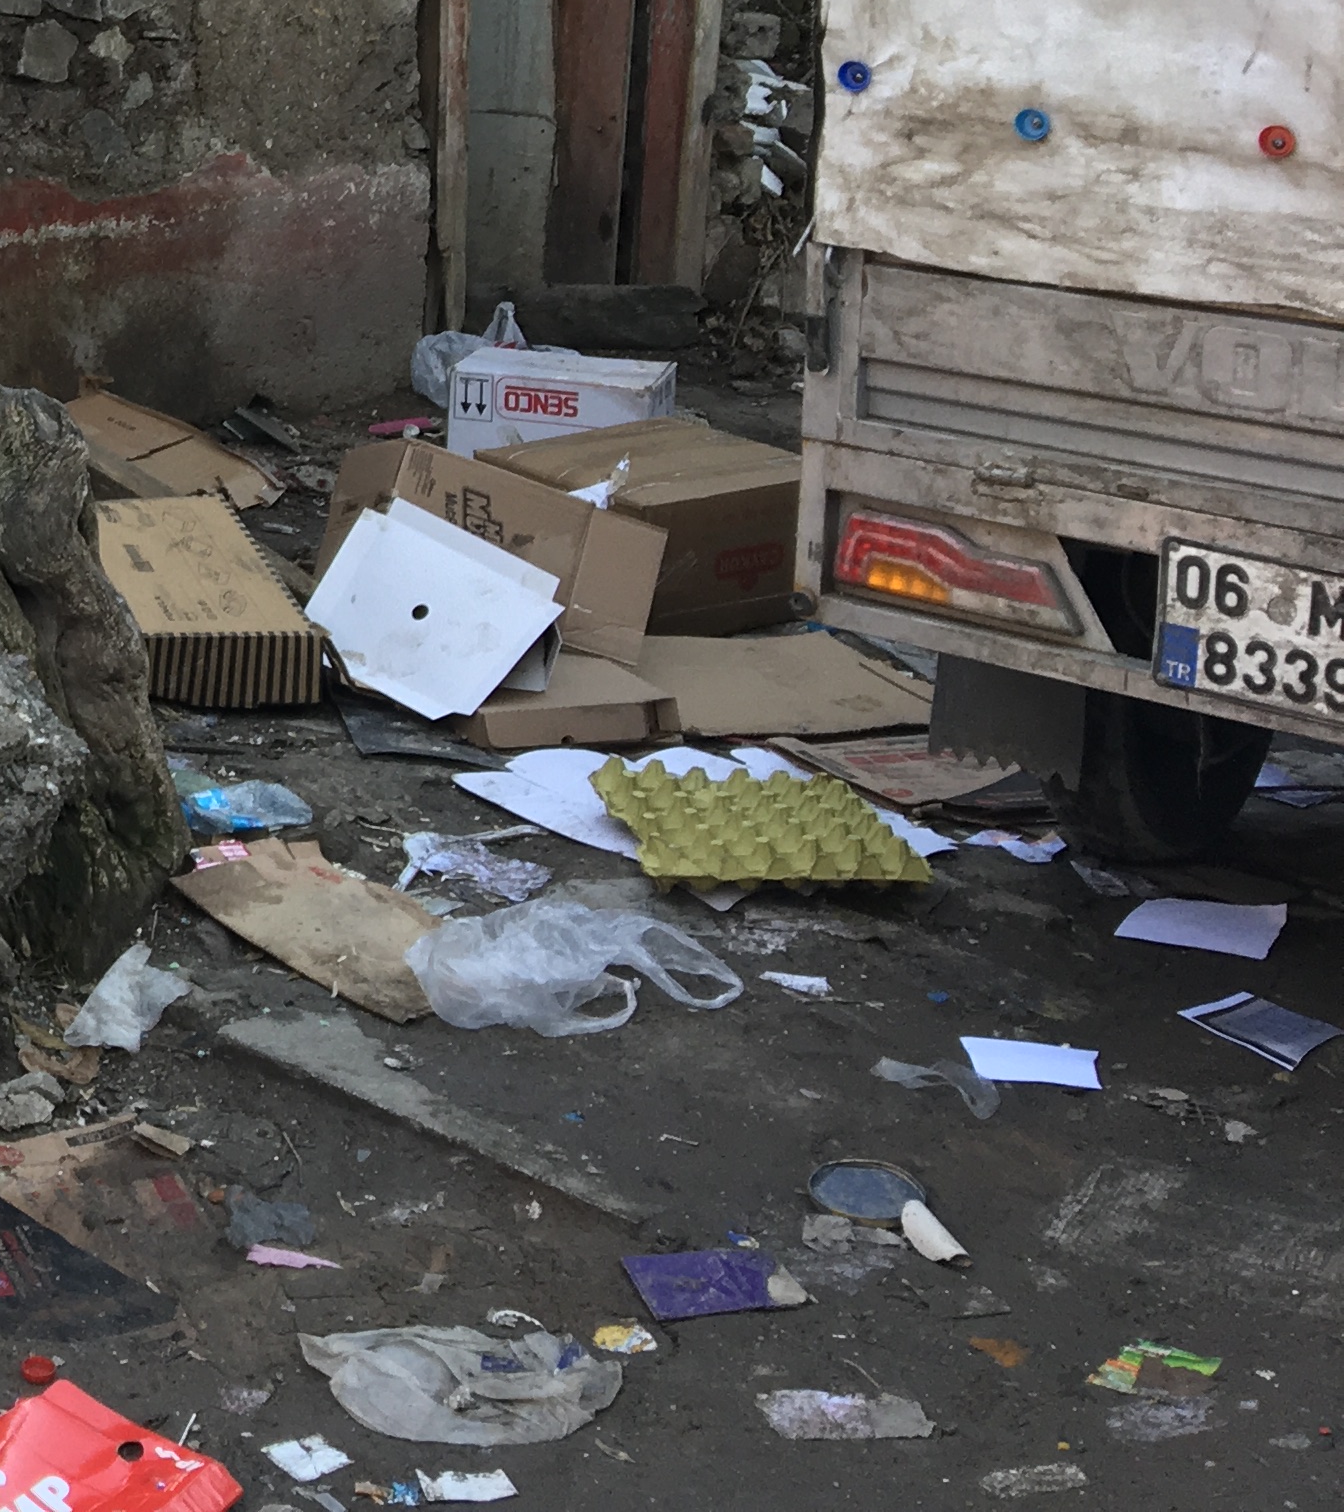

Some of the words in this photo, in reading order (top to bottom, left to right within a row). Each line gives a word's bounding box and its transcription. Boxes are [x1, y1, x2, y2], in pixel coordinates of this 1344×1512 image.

[504, 391, 579, 418] SENCO
[1176, 554, 1250, 618] 06
[1165, 660, 1191, 682] TR
[1203, 631, 1344, 714] 8339
